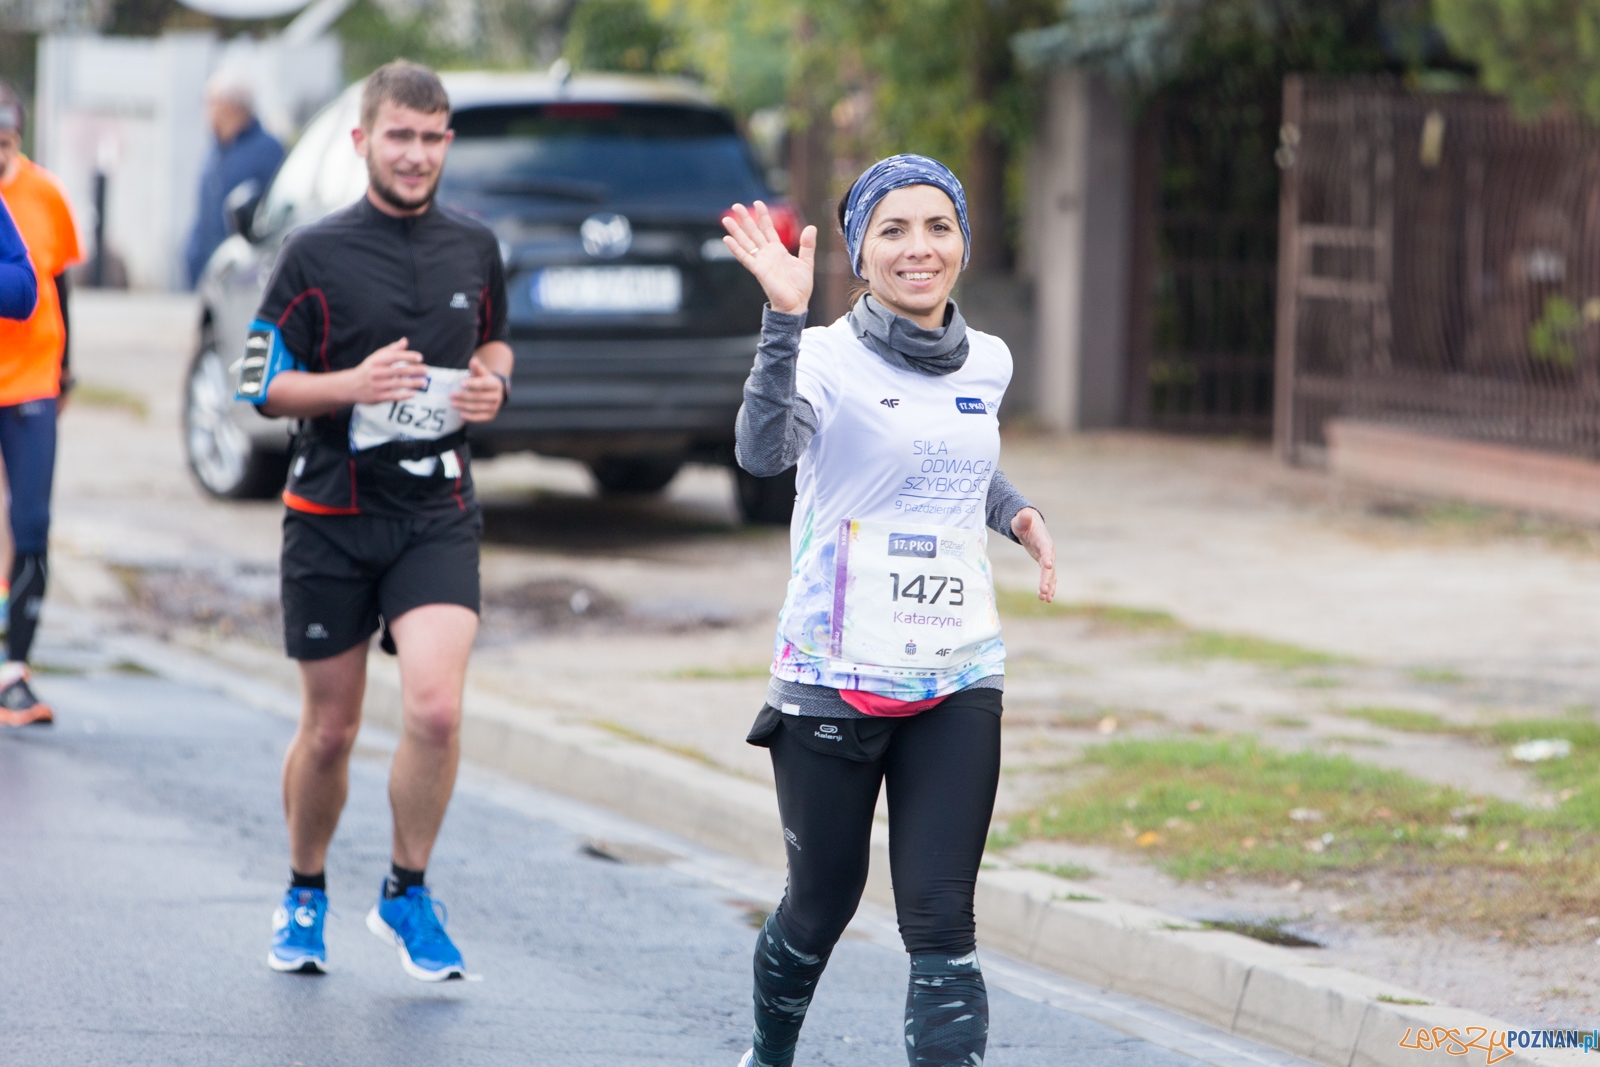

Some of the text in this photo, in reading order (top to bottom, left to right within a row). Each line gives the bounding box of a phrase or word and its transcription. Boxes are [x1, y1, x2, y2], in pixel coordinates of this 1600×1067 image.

[880, 398, 900, 408] 4F
[388, 400, 446, 432] 1625
[913, 440, 948, 455] SIŁA
[921, 459, 992, 475] ODWAGA
[902, 476, 988, 494] SZYBKOŚĆ
[894, 500, 903, 510] 9
[889, 572, 965, 607] 1473
[893, 611, 963, 629] Katarzyna
[935, 648, 952, 657] 4F
